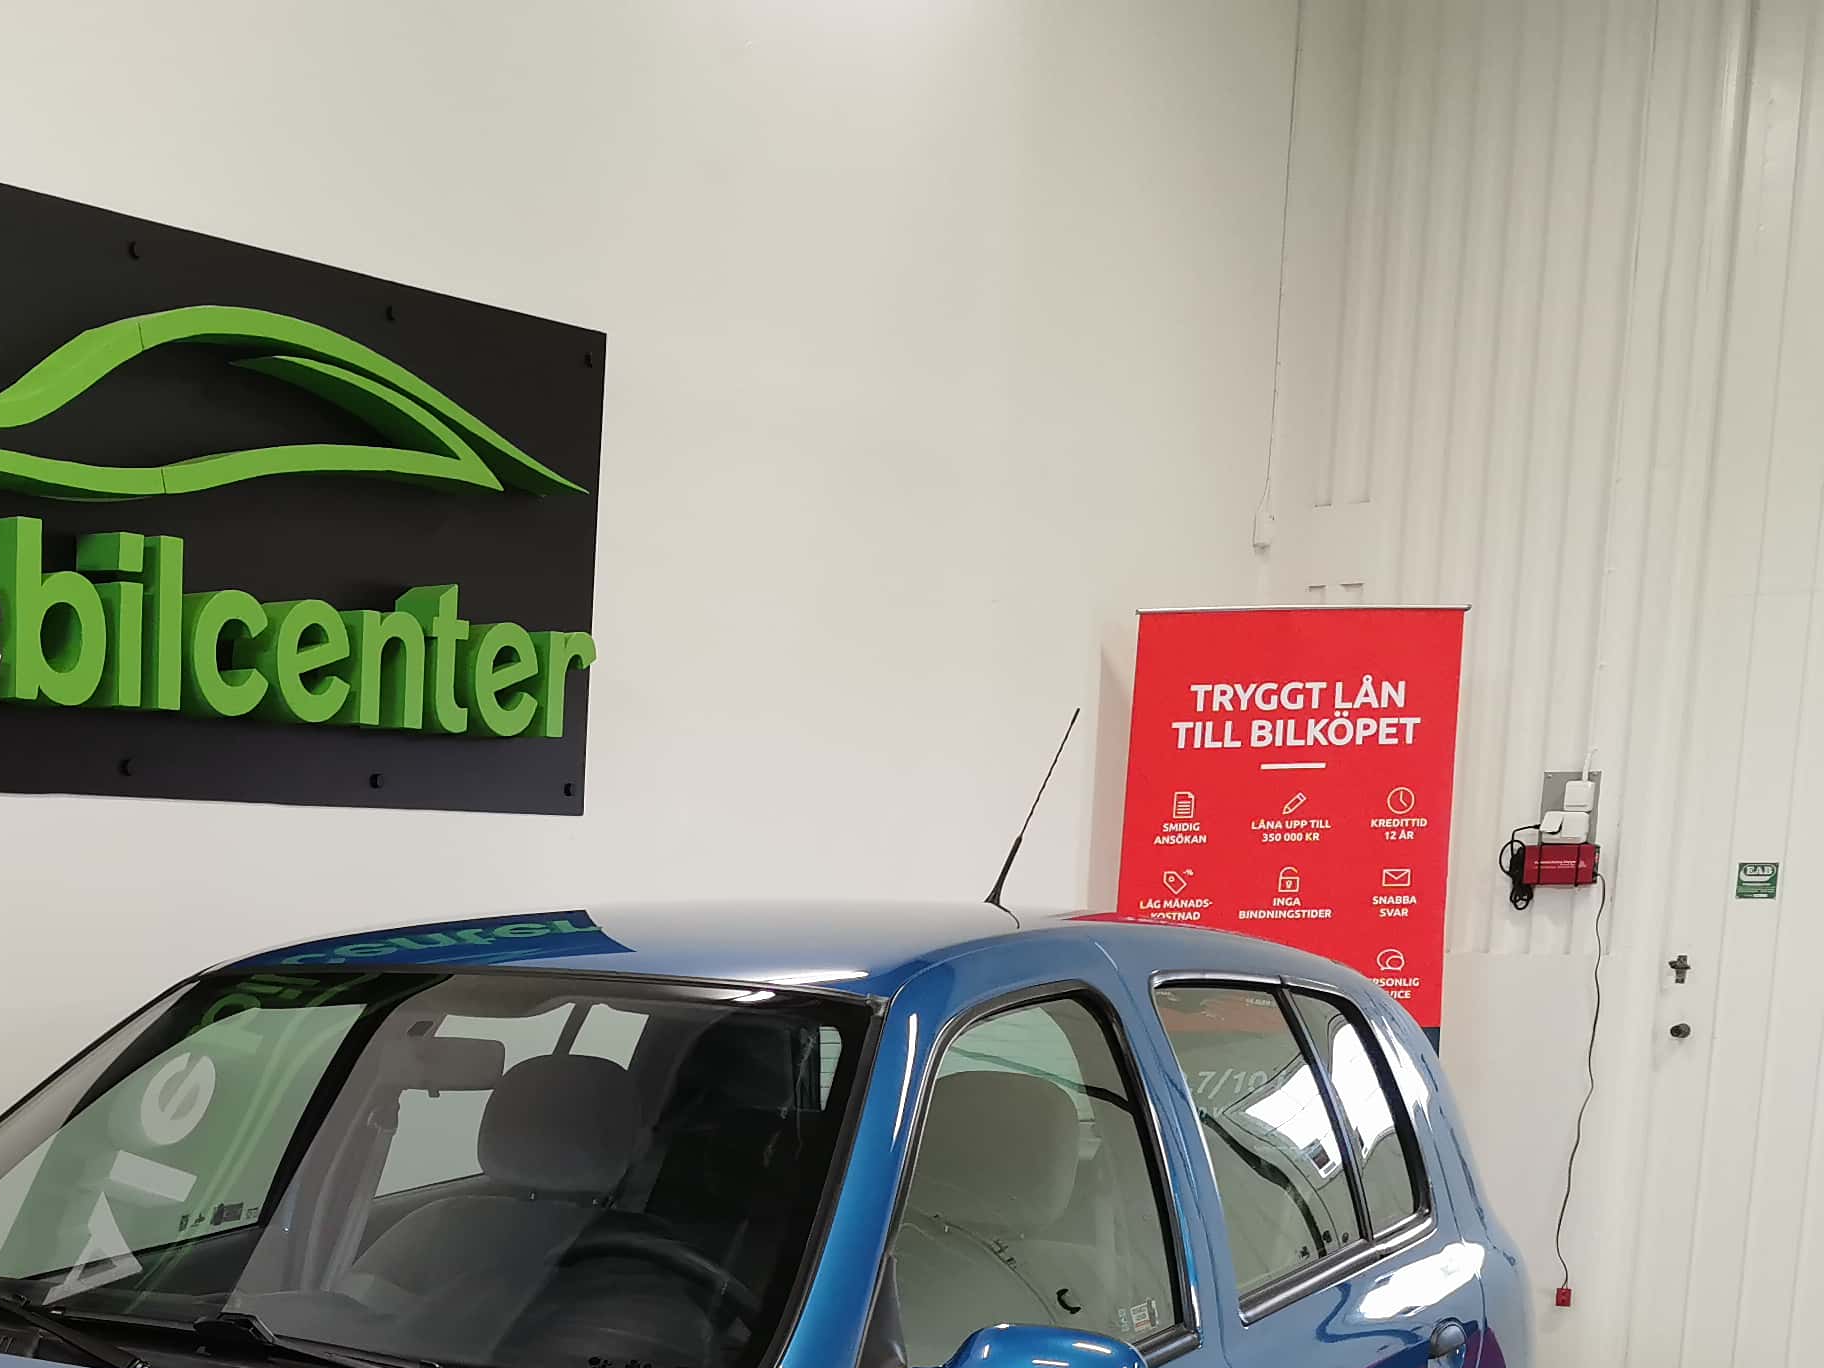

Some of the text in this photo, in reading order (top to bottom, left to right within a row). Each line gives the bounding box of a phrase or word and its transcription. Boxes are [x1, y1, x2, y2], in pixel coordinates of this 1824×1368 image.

[1190, 674, 1406, 713] TRYGGT LÅN
[1171, 711, 1422, 749] TILL BILKÖPET
[1162, 822, 1201, 832] SMIDIG
[1251, 819, 1332, 830] LÅNA UPP TILL
[1370, 817, 1428, 828] KREDITTID
[1154, 834, 1207, 845] ANSÖKAN
[1262, 831, 1320, 842] 350 000 KR
[1385, 829, 1415, 840] 12 ÅR
[1139, 898, 1213, 909] LÅG MÅNADS-
[1273, 897, 1301, 906] INGA
[1372, 895, 1417, 905] SNABBA
[1239, 908, 1332, 920] BINDNINGSTIDER
[1379, 907, 1409, 917] SVAR
